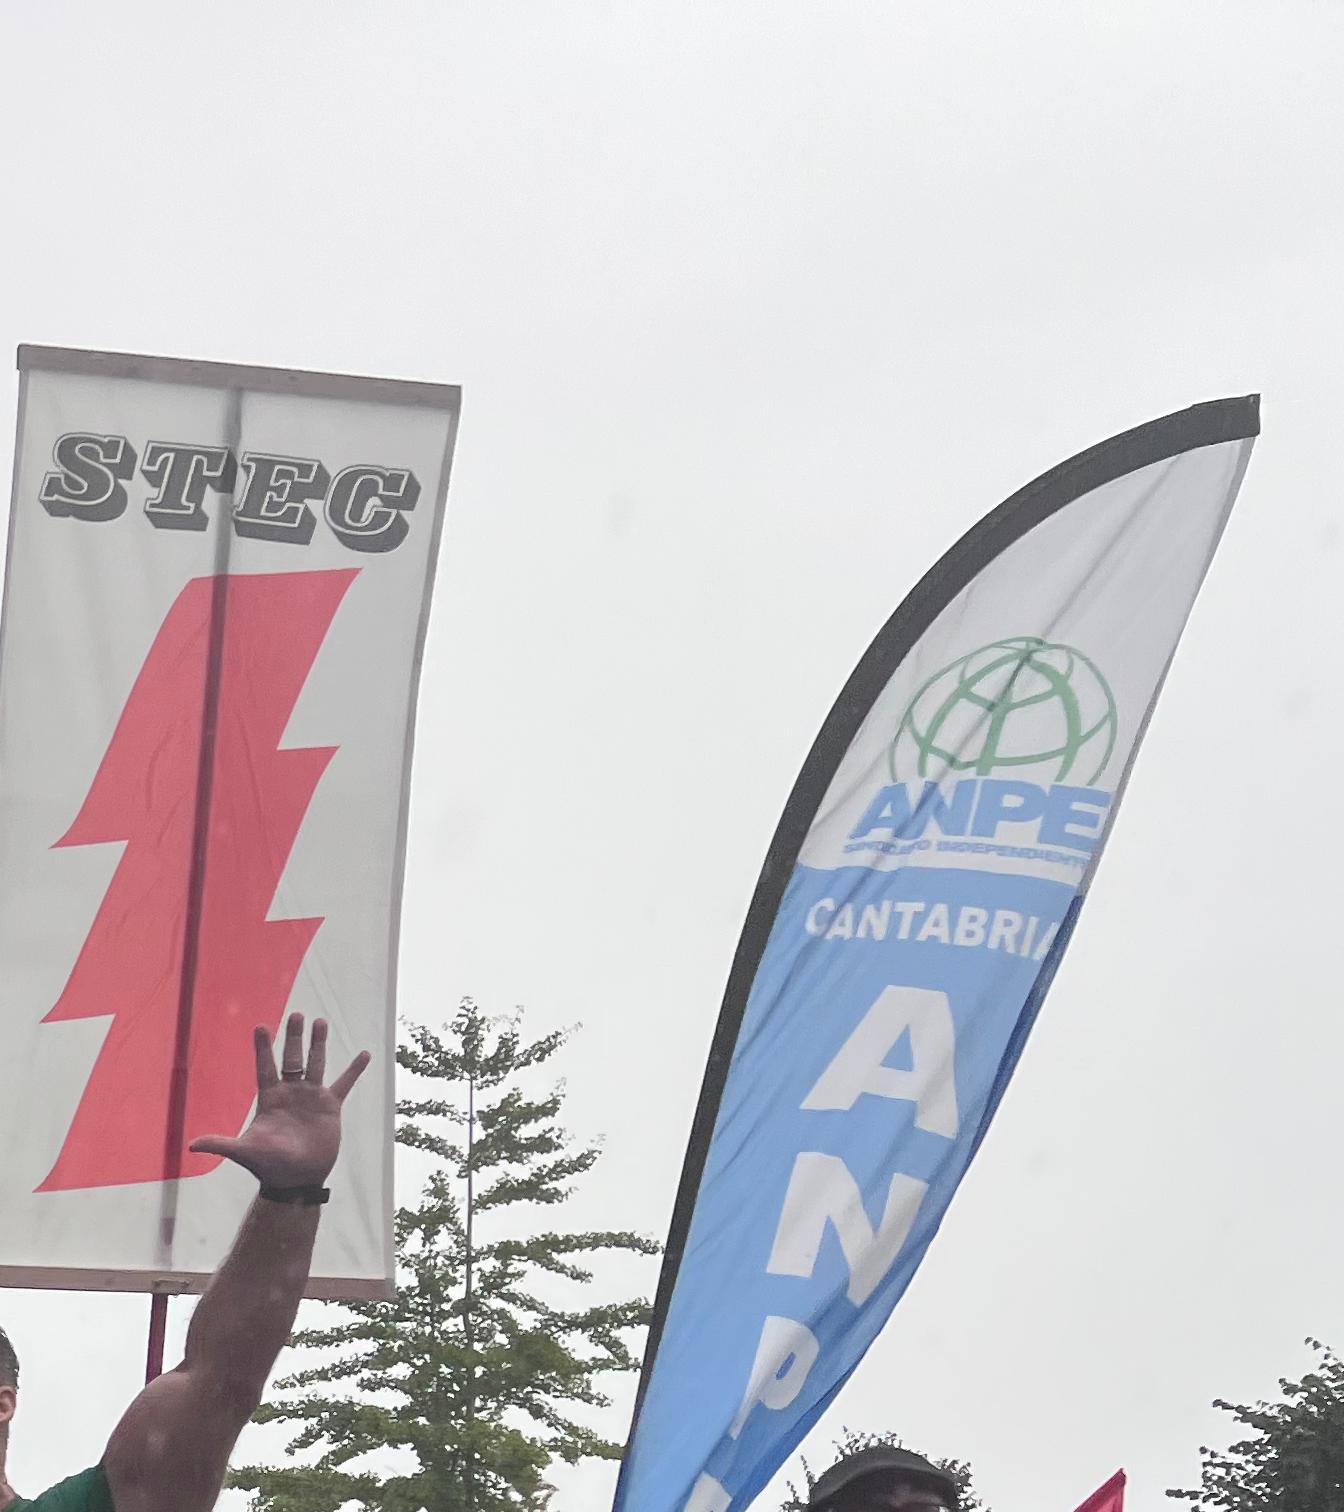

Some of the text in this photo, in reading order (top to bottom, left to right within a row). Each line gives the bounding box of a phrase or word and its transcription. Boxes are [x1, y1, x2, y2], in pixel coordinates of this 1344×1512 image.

[39, 432, 422, 553] STEC
[849, 778, 1112, 853] ANPE
[805, 896, 1059, 962] CANTABRIA
